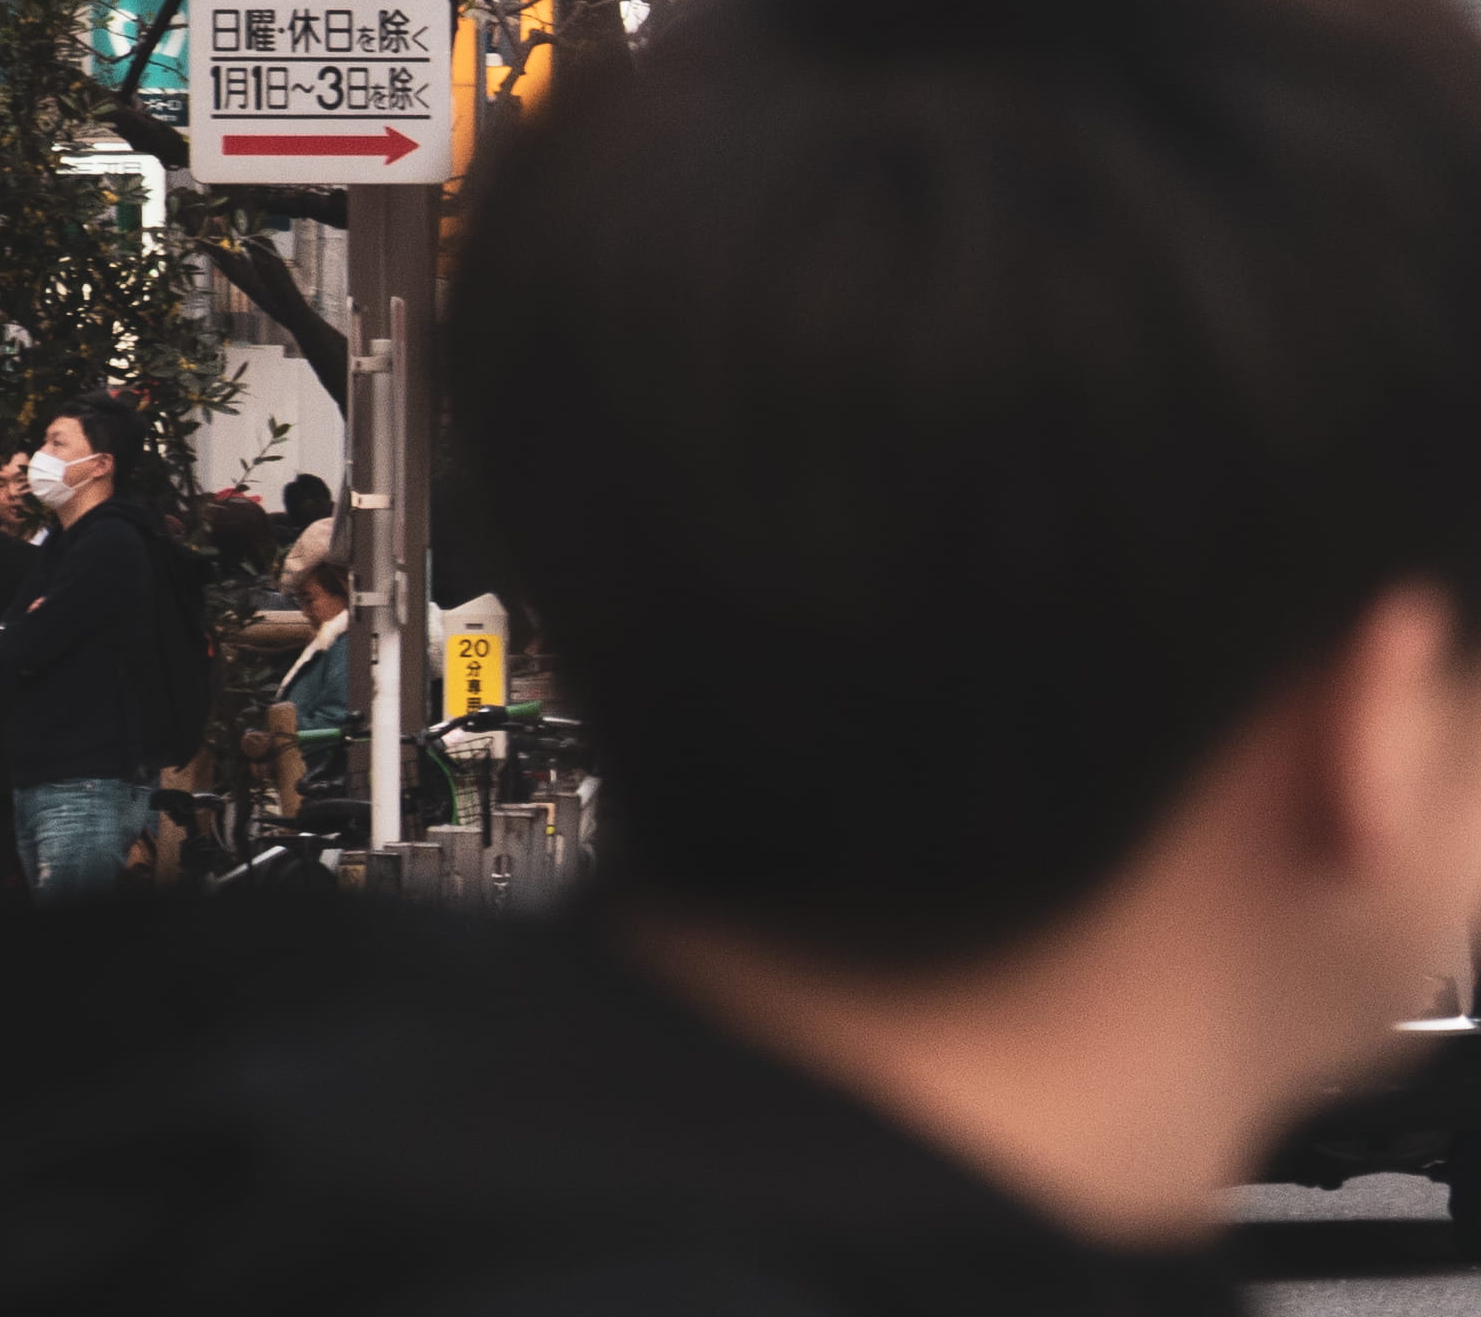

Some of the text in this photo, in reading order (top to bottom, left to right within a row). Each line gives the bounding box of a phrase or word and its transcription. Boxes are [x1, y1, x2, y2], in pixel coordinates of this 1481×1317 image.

[212, 9, 429, 54] 日曜・休日を除く
